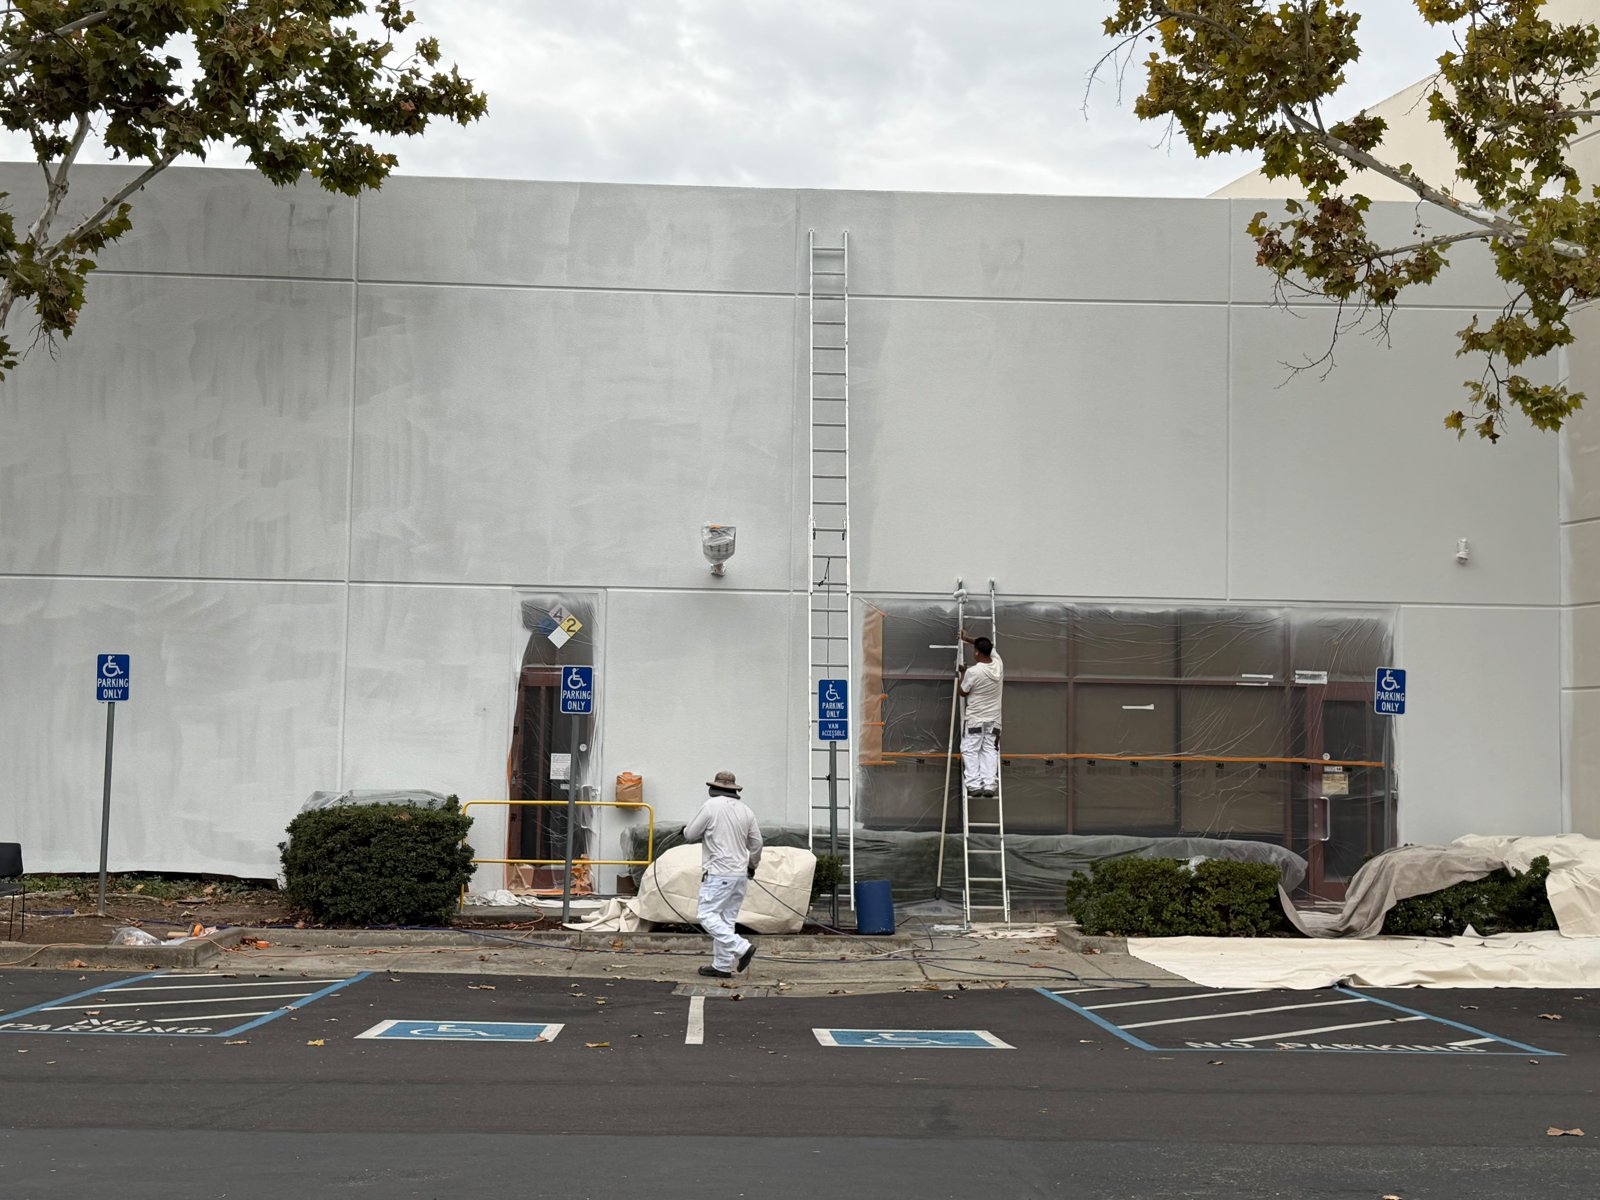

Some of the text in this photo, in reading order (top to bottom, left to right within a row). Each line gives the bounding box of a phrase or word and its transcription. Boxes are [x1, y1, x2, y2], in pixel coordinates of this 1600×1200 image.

[553, 608, 563, 619] 4
[566, 618, 577, 633] 2
[97, 678, 129, 688] PARKING
[103, 688, 123, 699] ONLY
[562, 690, 592, 700] PARKING
[1376, 691, 1405, 702] PARKING
[567, 700, 586, 711] ONLY
[821, 702, 845, 710] PARKING
[1381, 701, 1400, 712] ONLY
[826, 710, 841, 718] ONLY
[74, 1018, 148, 1027] NO
[0, 1023, 212, 1034] PARKING
[1185, 1041, 1487, 1052] NO PARKING
